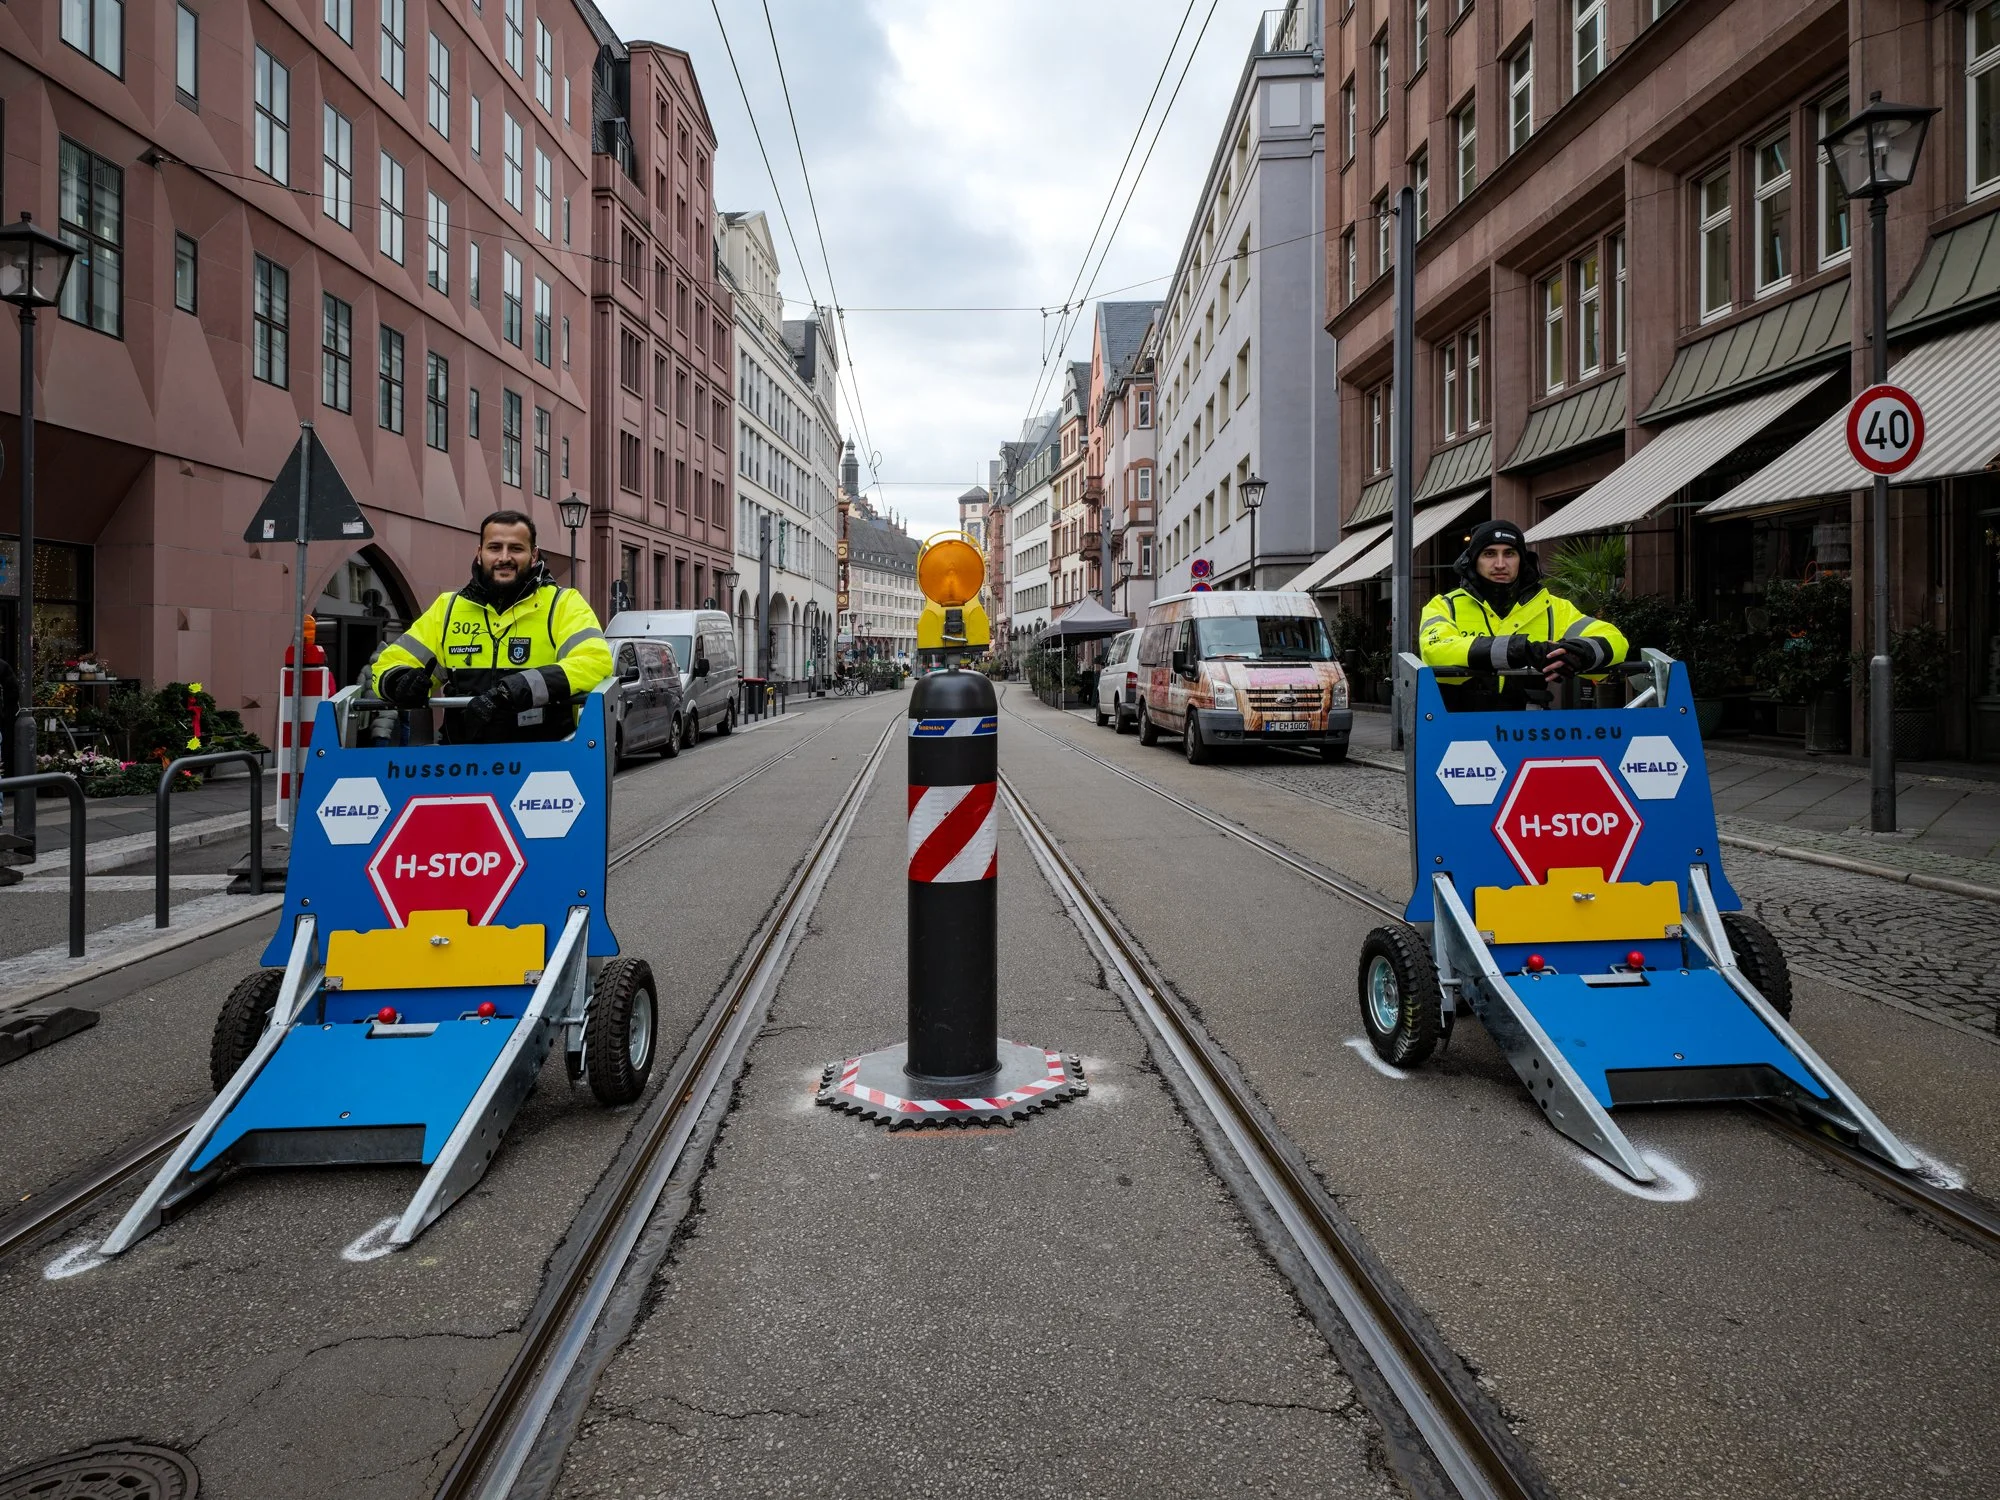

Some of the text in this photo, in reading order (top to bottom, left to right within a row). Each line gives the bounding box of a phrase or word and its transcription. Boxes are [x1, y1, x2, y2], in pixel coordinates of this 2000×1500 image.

[1865, 410, 1909, 449] 40
[452, 622, 480, 635] 302
[1496, 725, 1622, 742] husson.eu
[387, 760, 521, 779] husson.eu
[1444, 767, 1496, 778] HEALD
[1627, 762, 1678, 773] HEALD
[324, 805, 379, 817] HEALD
[519, 798, 574, 810] HEALD
[1520, 813, 1619, 838] H-STOP
[395, 852, 501, 879] H-STOP
